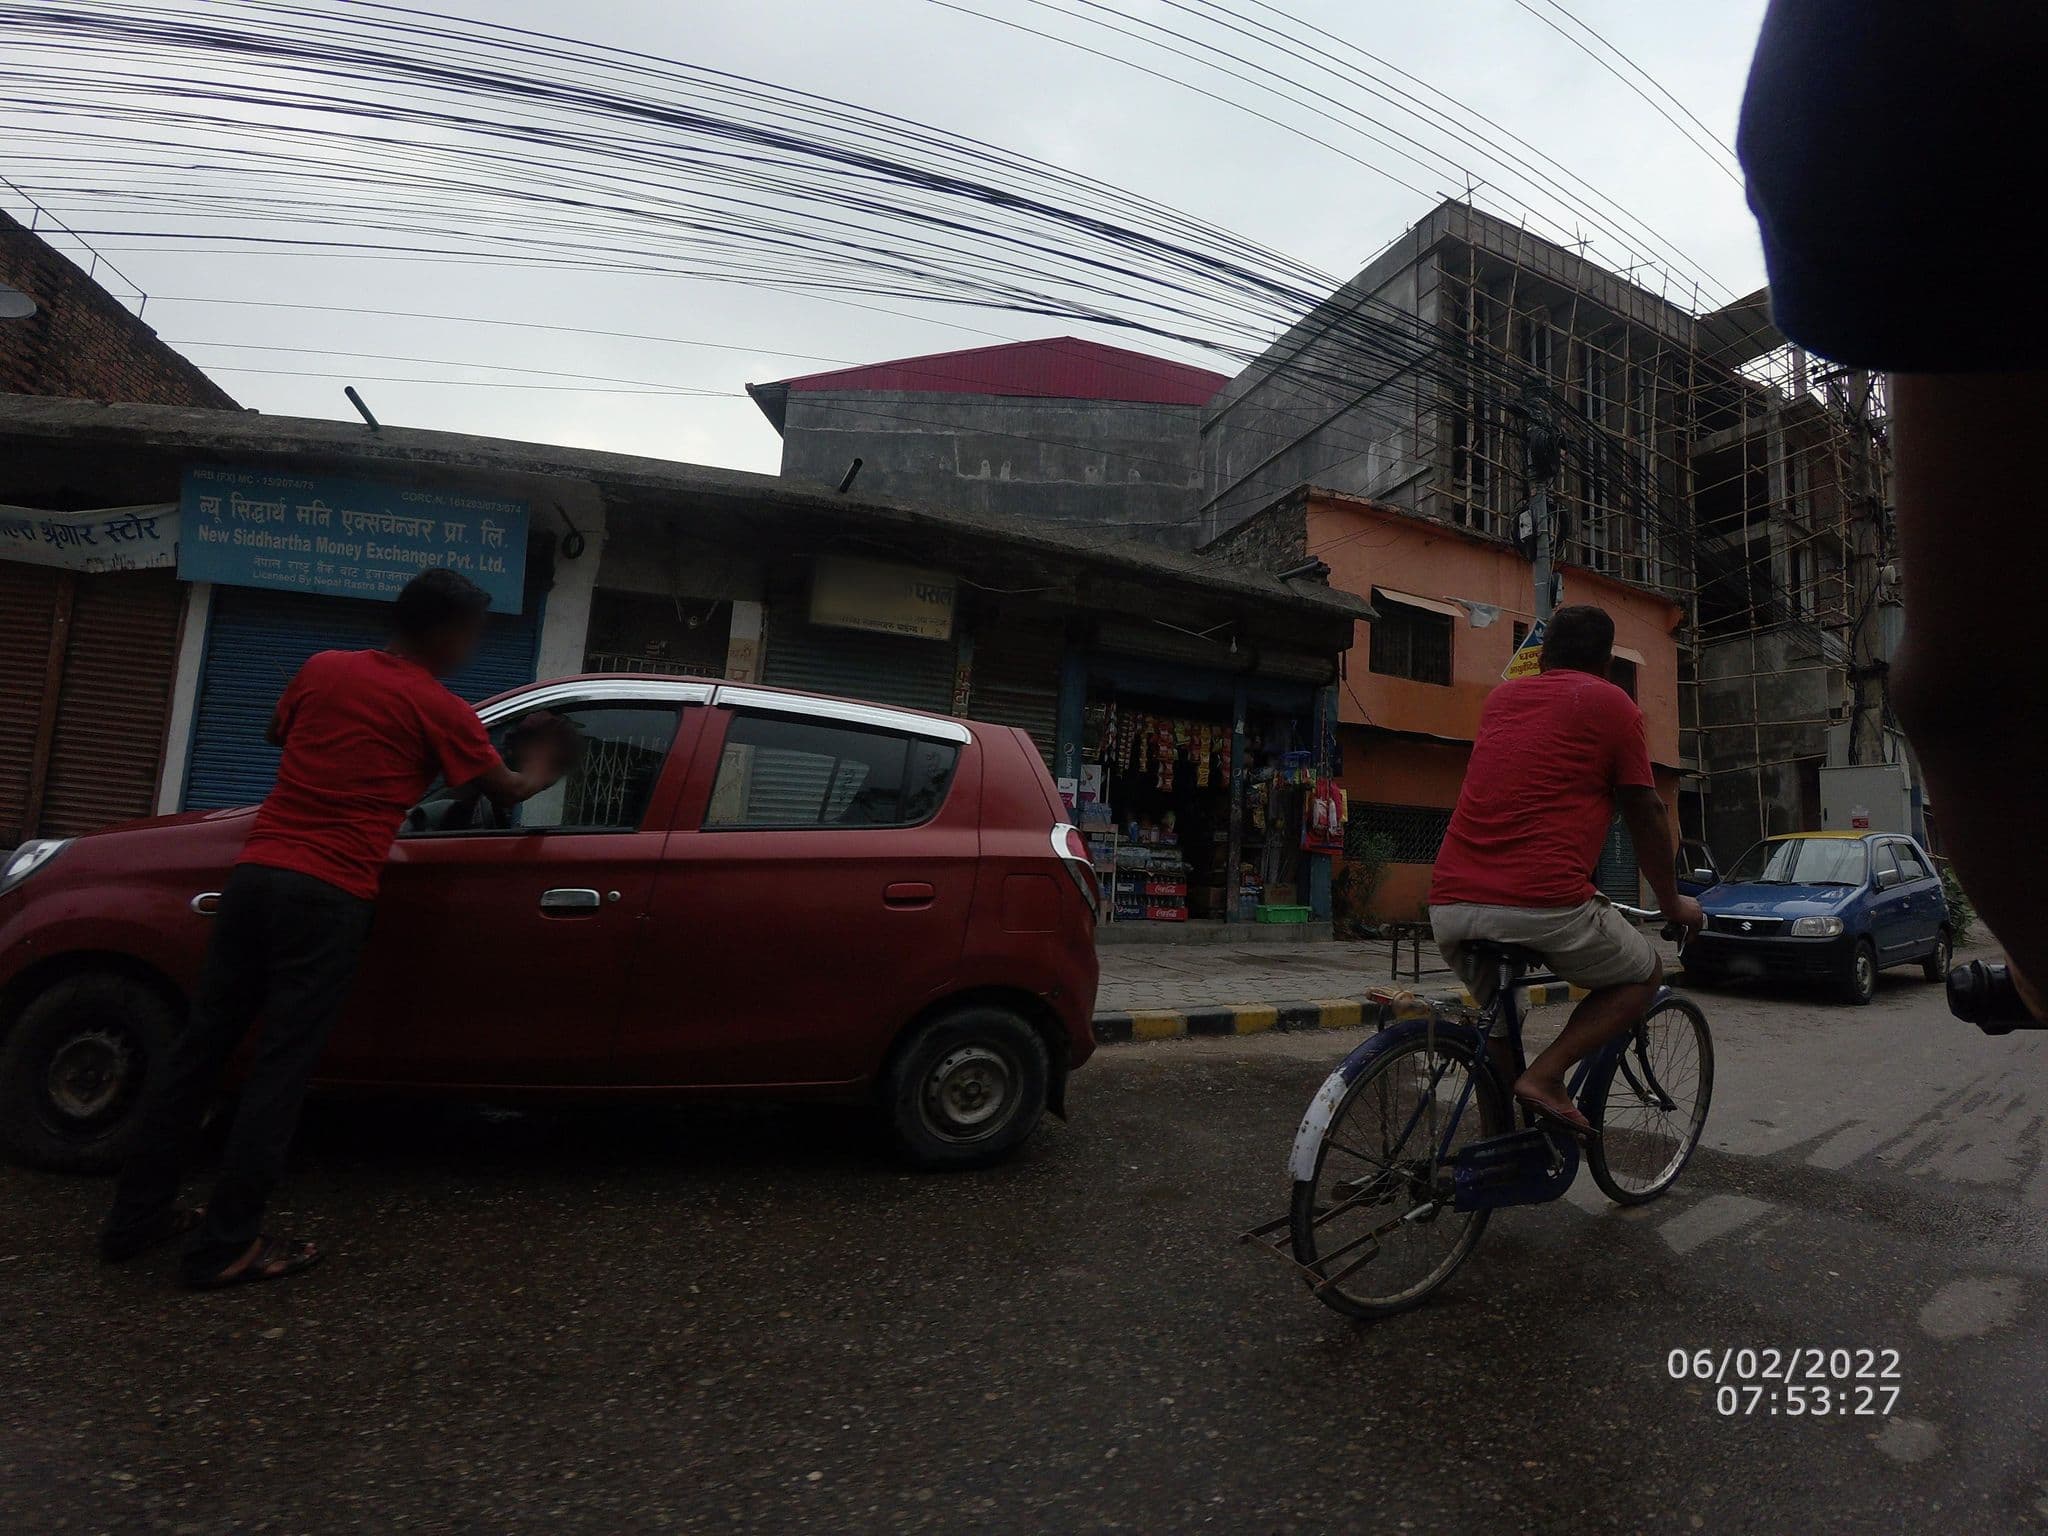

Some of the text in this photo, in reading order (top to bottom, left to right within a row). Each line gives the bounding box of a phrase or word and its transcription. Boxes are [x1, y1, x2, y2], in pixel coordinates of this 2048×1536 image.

[199, 495, 221, 525] न्यू
[230, 491, 287, 522] सिद्धार्थ
[296, 498, 333, 528] मनि
[103, 512, 161, 543] स्टोर
[198, 526, 507, 574] New Siddhartha Money Exchanger Pvt. Ltd.
[252, 571, 296, 583] Licensed
[298, 574, 311, 586] By
[314, 577, 342, 588] Nepal
